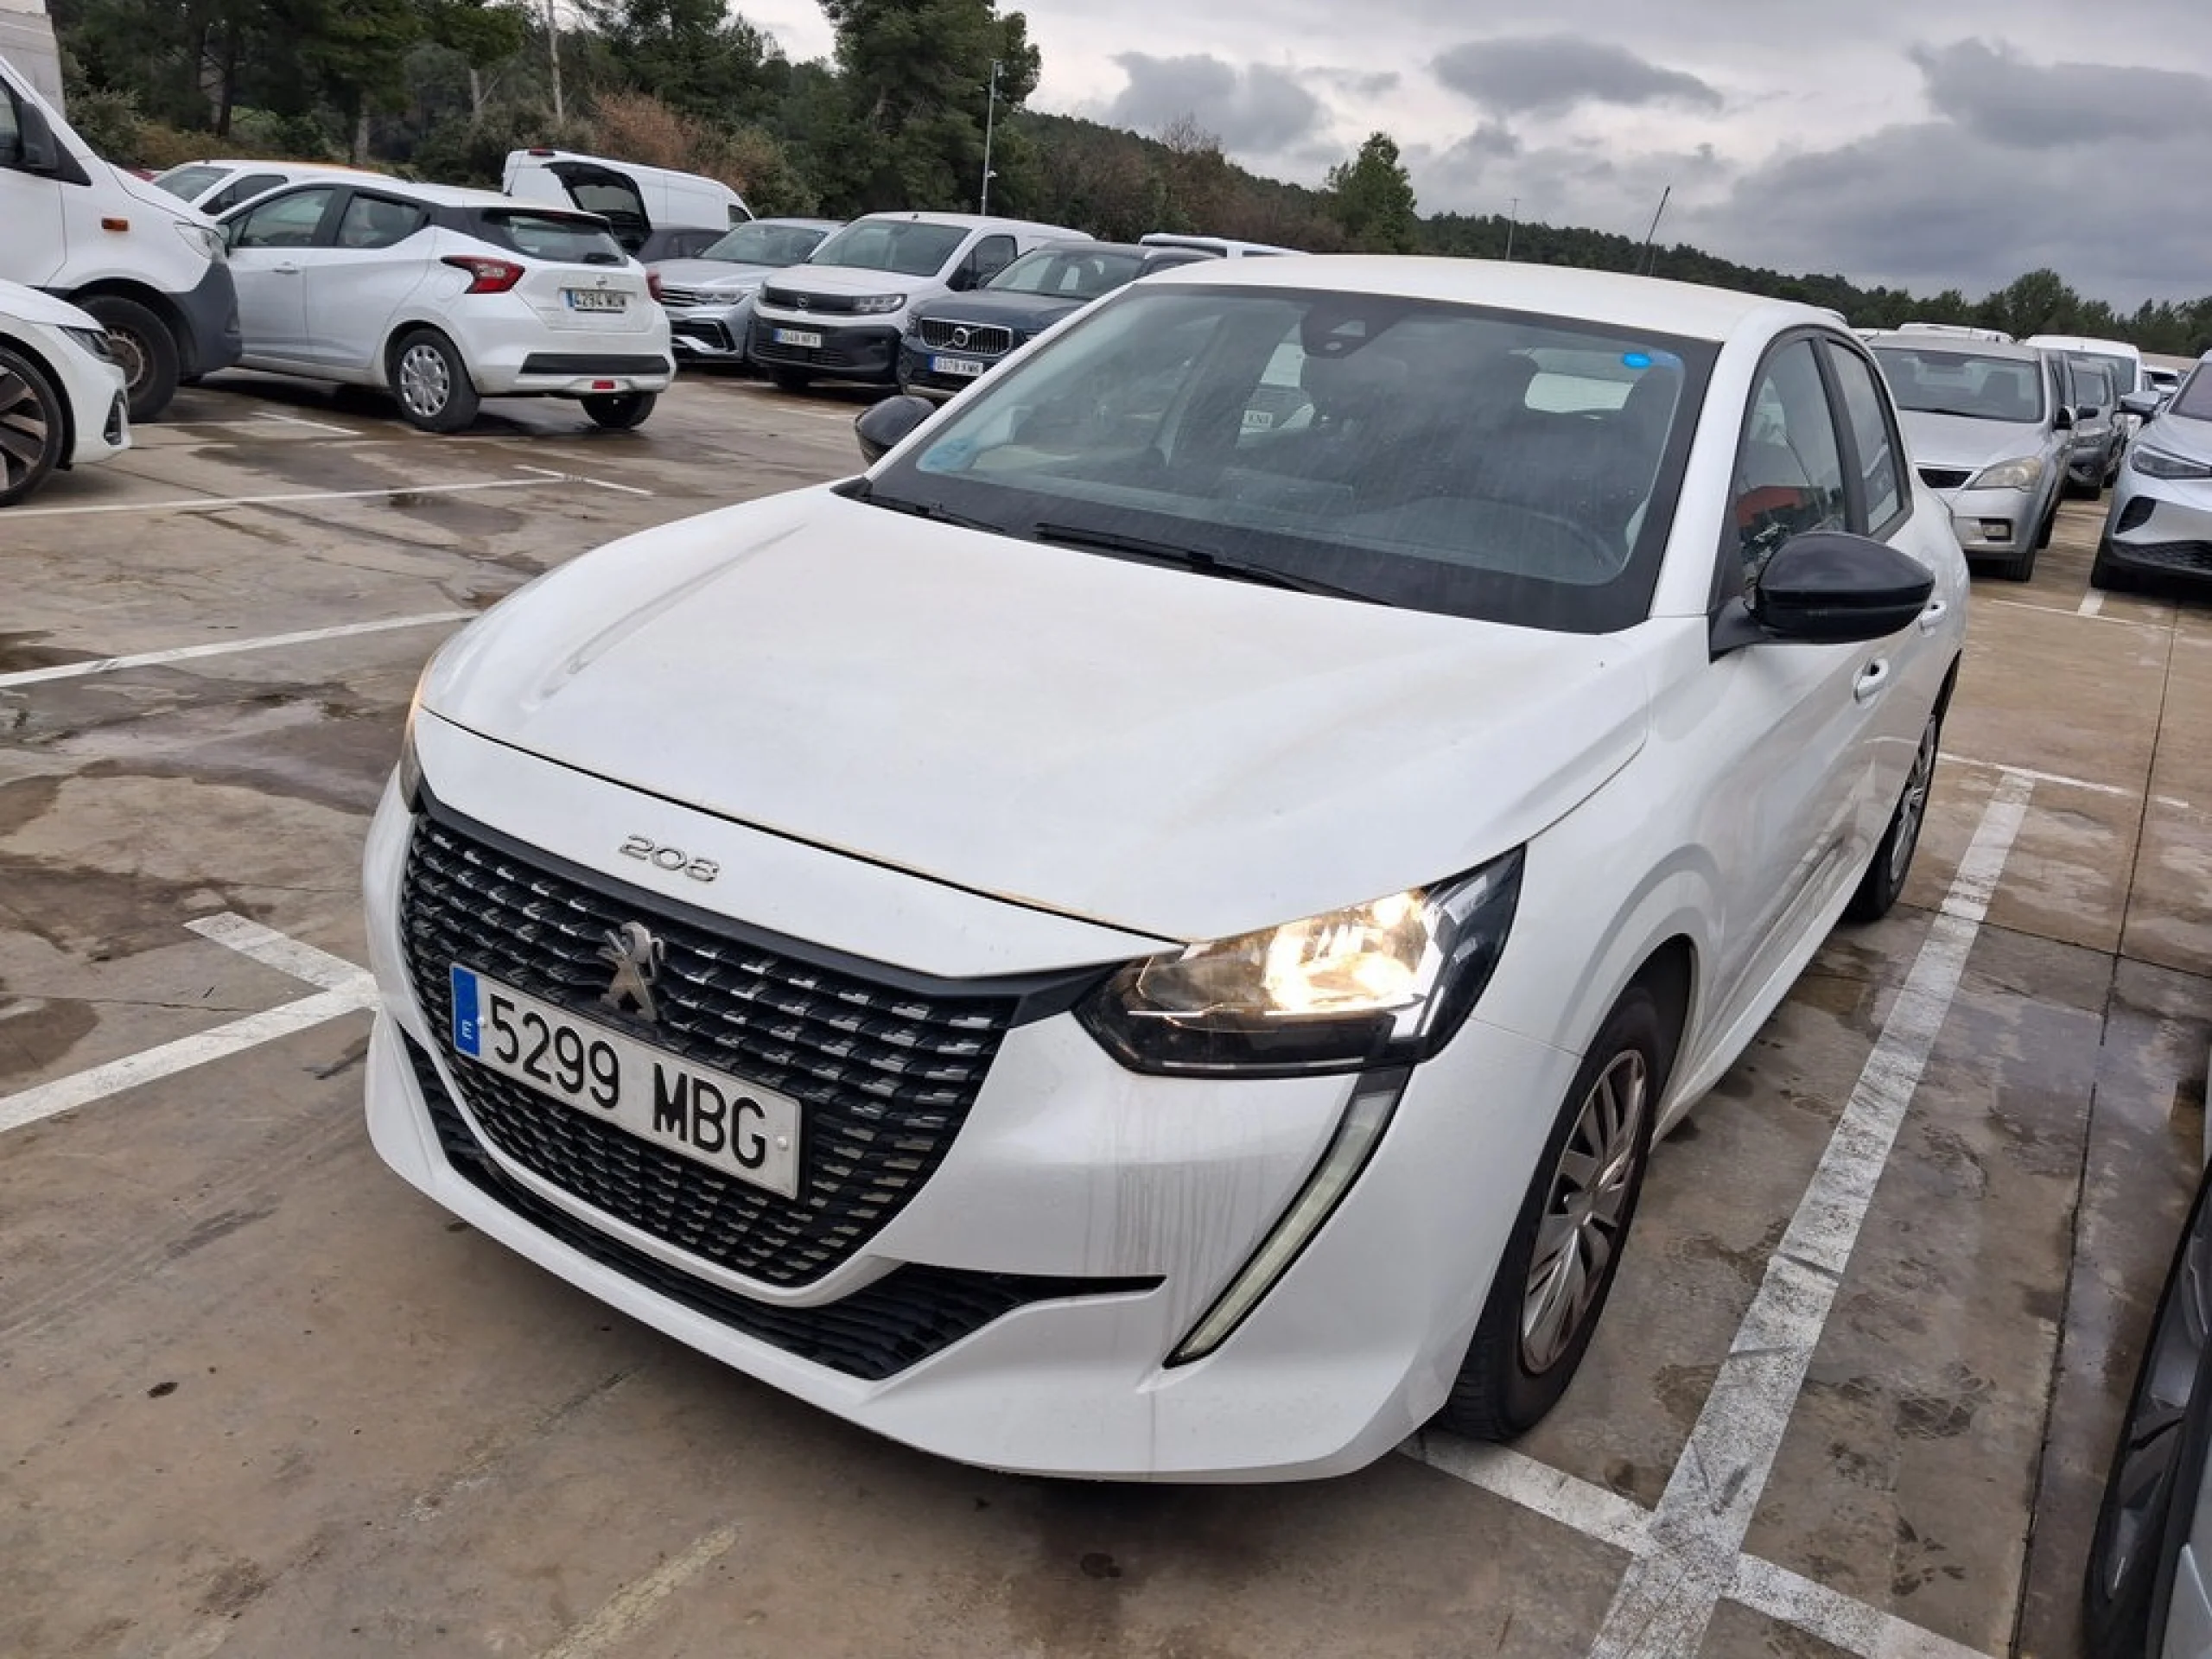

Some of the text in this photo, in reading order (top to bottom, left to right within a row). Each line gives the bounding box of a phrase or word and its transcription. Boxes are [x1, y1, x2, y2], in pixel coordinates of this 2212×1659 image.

[618, 833, 720, 881] 208
[461, 1019, 474, 1040] E
[489, 993, 766, 1169] 5299 MBG
